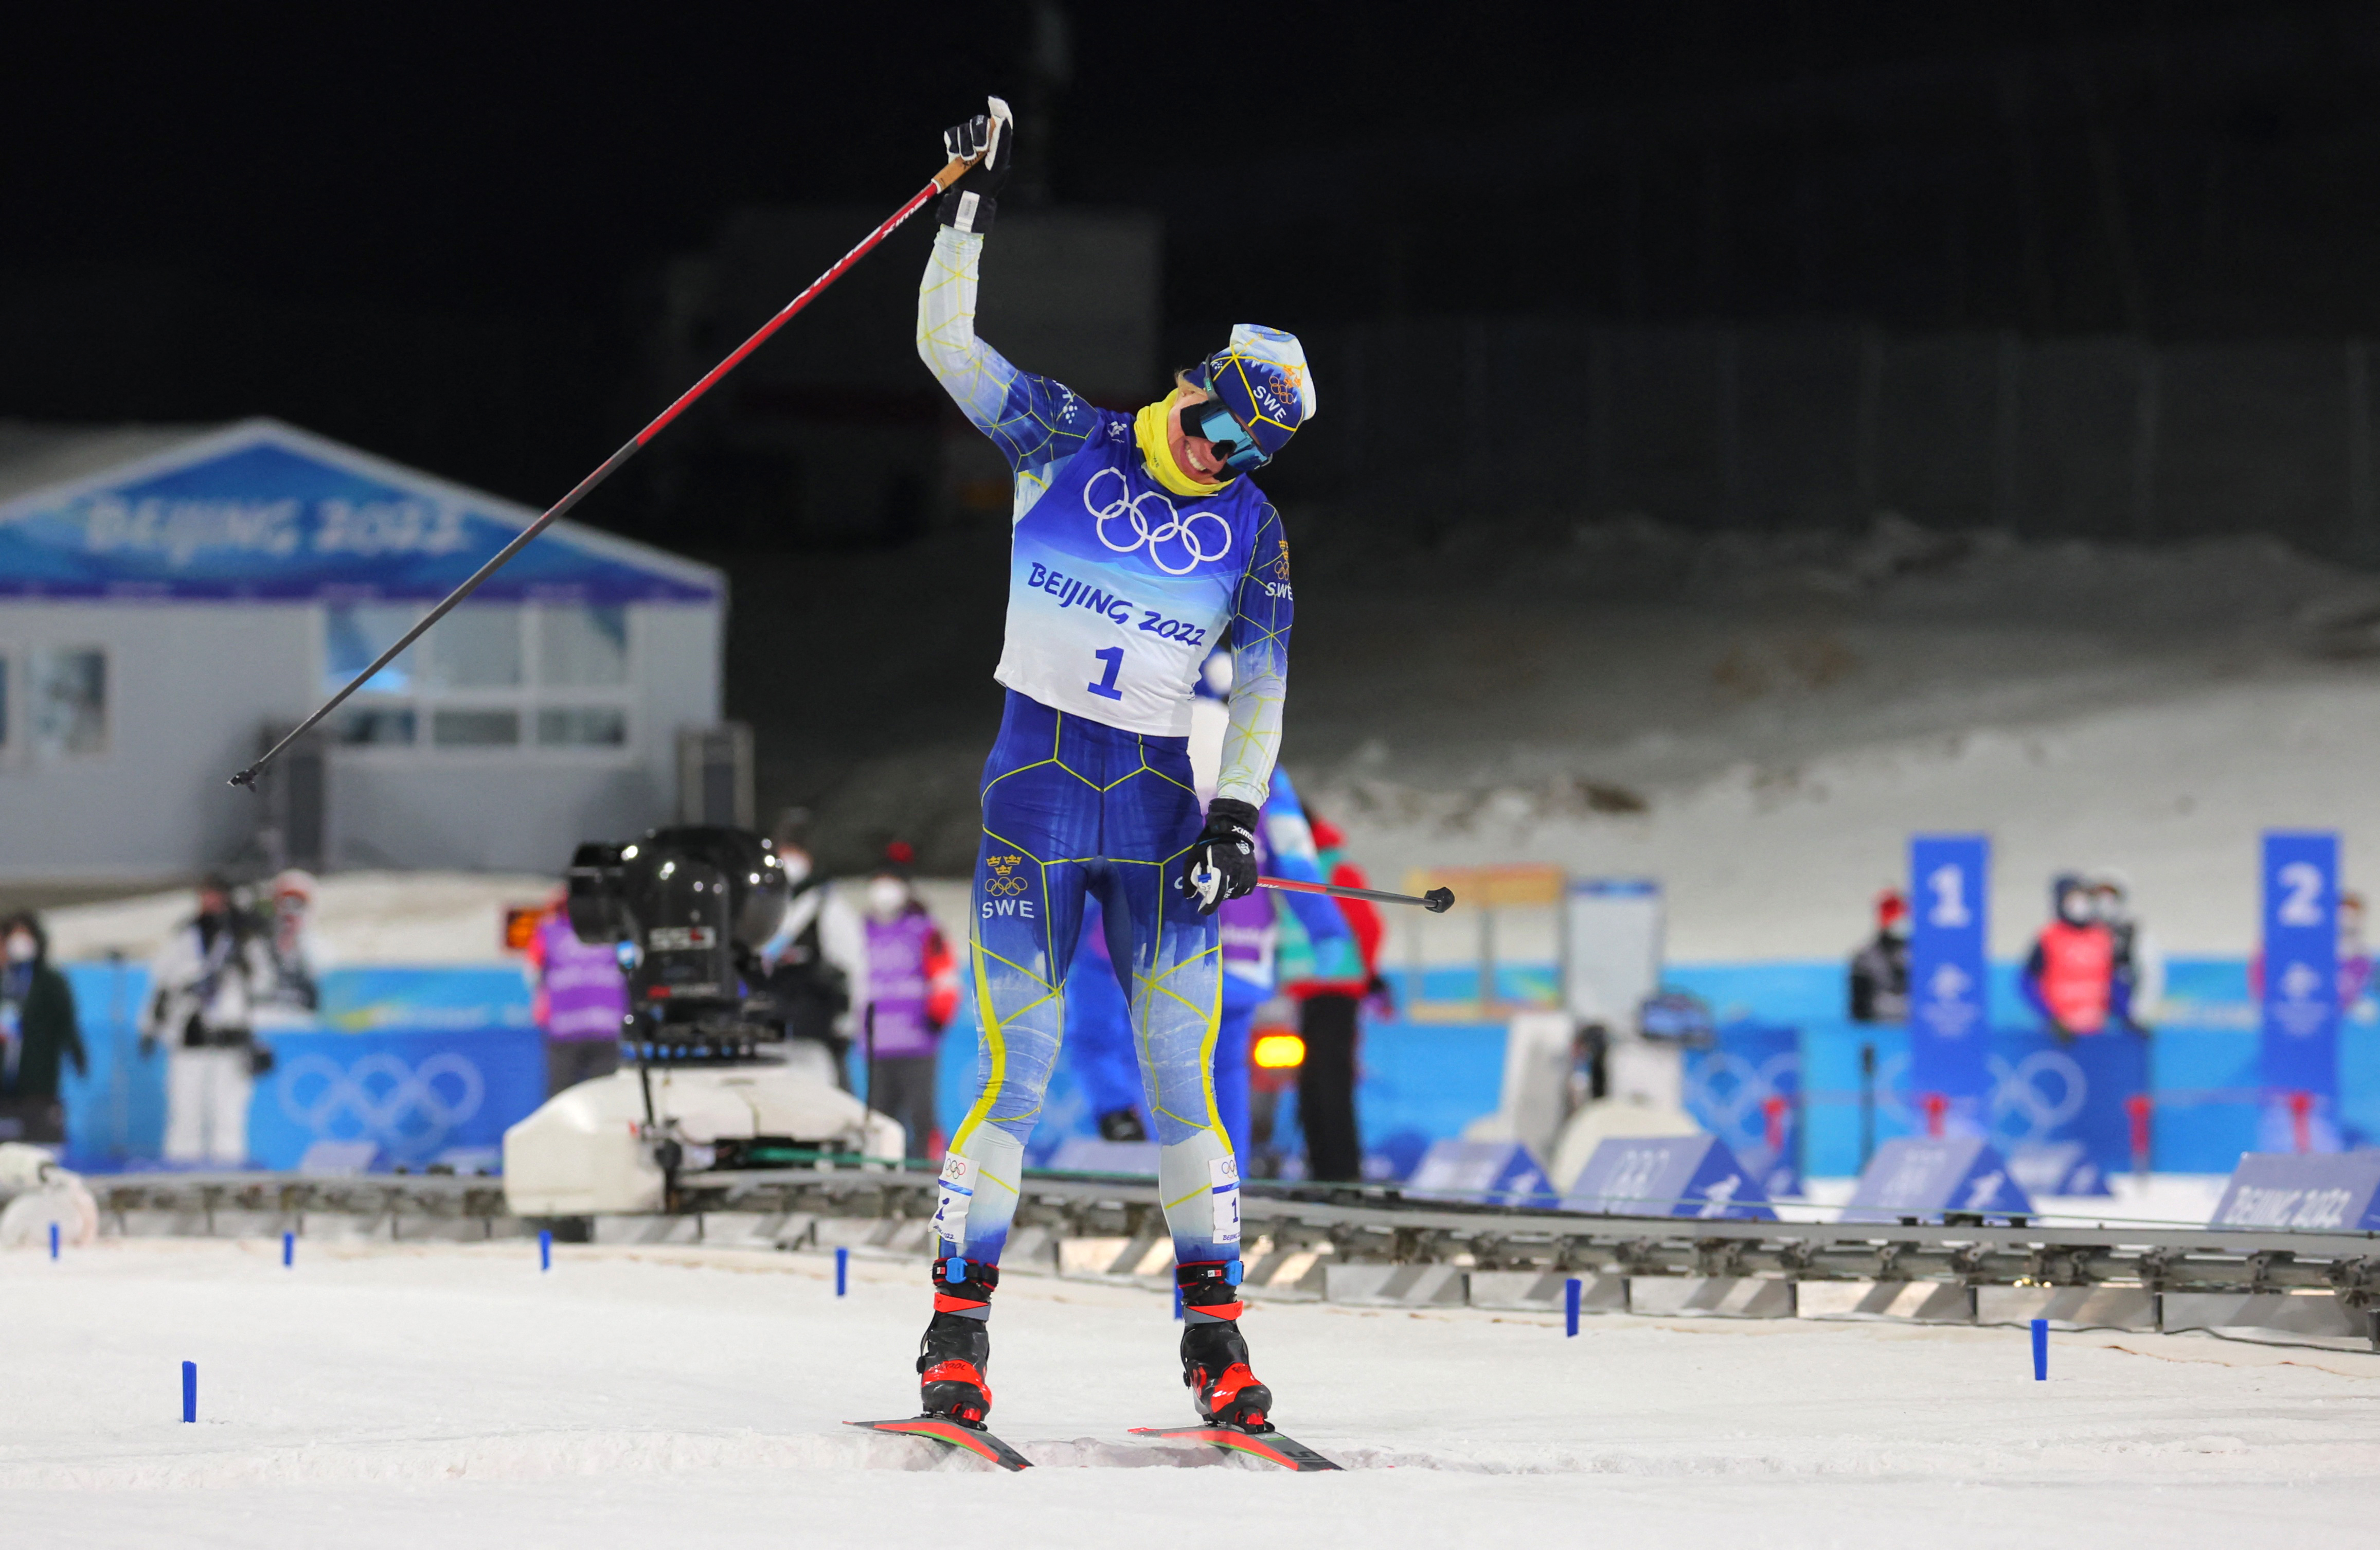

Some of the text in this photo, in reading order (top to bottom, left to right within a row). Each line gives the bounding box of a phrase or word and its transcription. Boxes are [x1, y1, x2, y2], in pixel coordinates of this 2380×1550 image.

[1253, 385, 1286, 422] SWE
[1027, 561, 1206, 647] BEIJING 2022
[1265, 581, 1293, 601] SWE
[1087, 646, 1124, 701] 1
[981, 899, 1035, 918] SWE
[1928, 863, 1972, 928] 1
[2277, 861, 2324, 927] 2
[1231, 1197, 1239, 1223] 1
